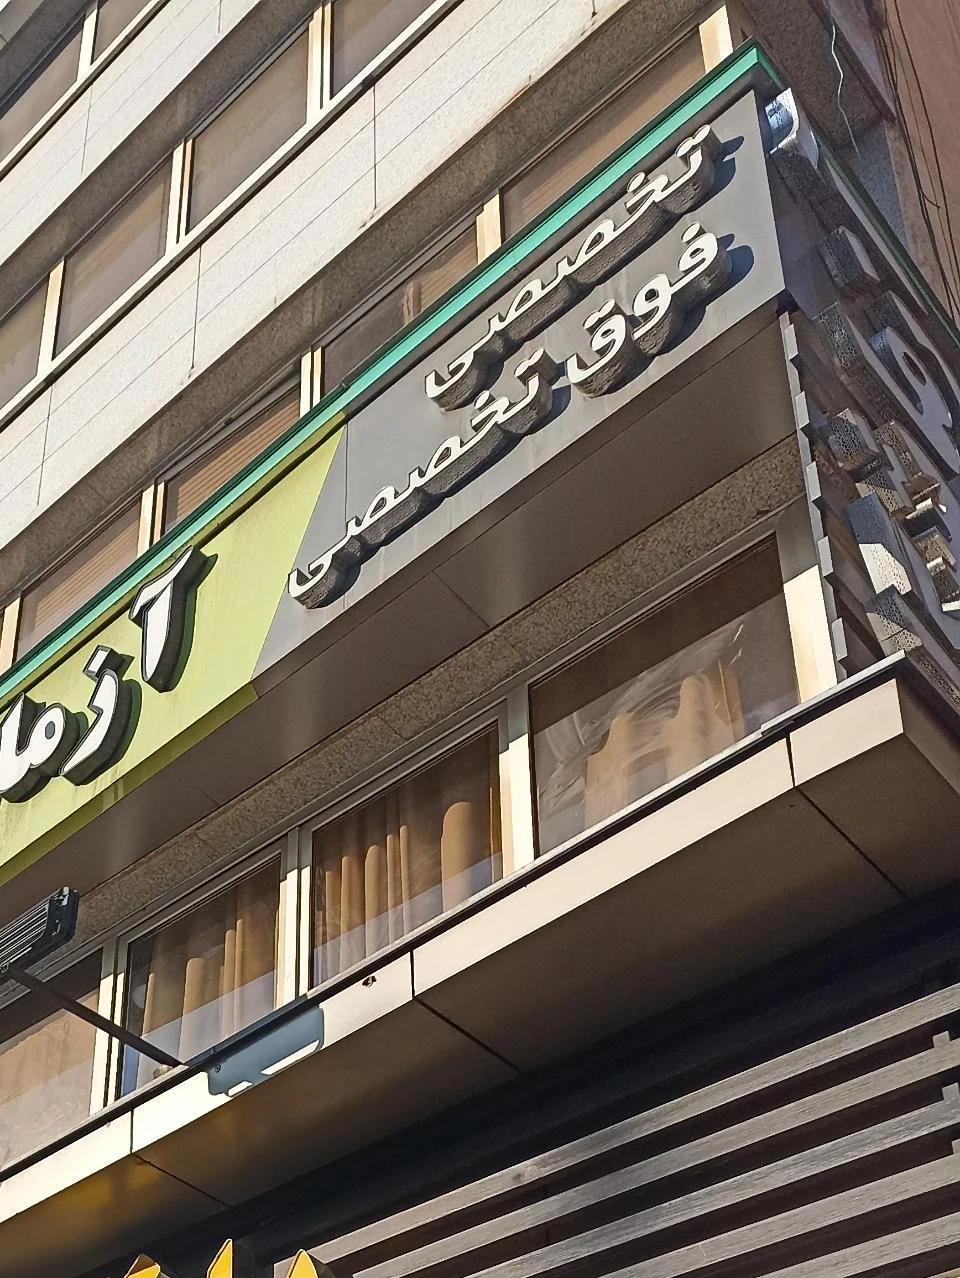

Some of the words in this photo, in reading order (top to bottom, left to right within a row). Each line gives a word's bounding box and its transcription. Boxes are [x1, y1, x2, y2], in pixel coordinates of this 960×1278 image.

[424, 124, 712, 398] تخصصی
[565, 221, 720, 383] فوق
[287, 347, 549, 598] تخصصی
